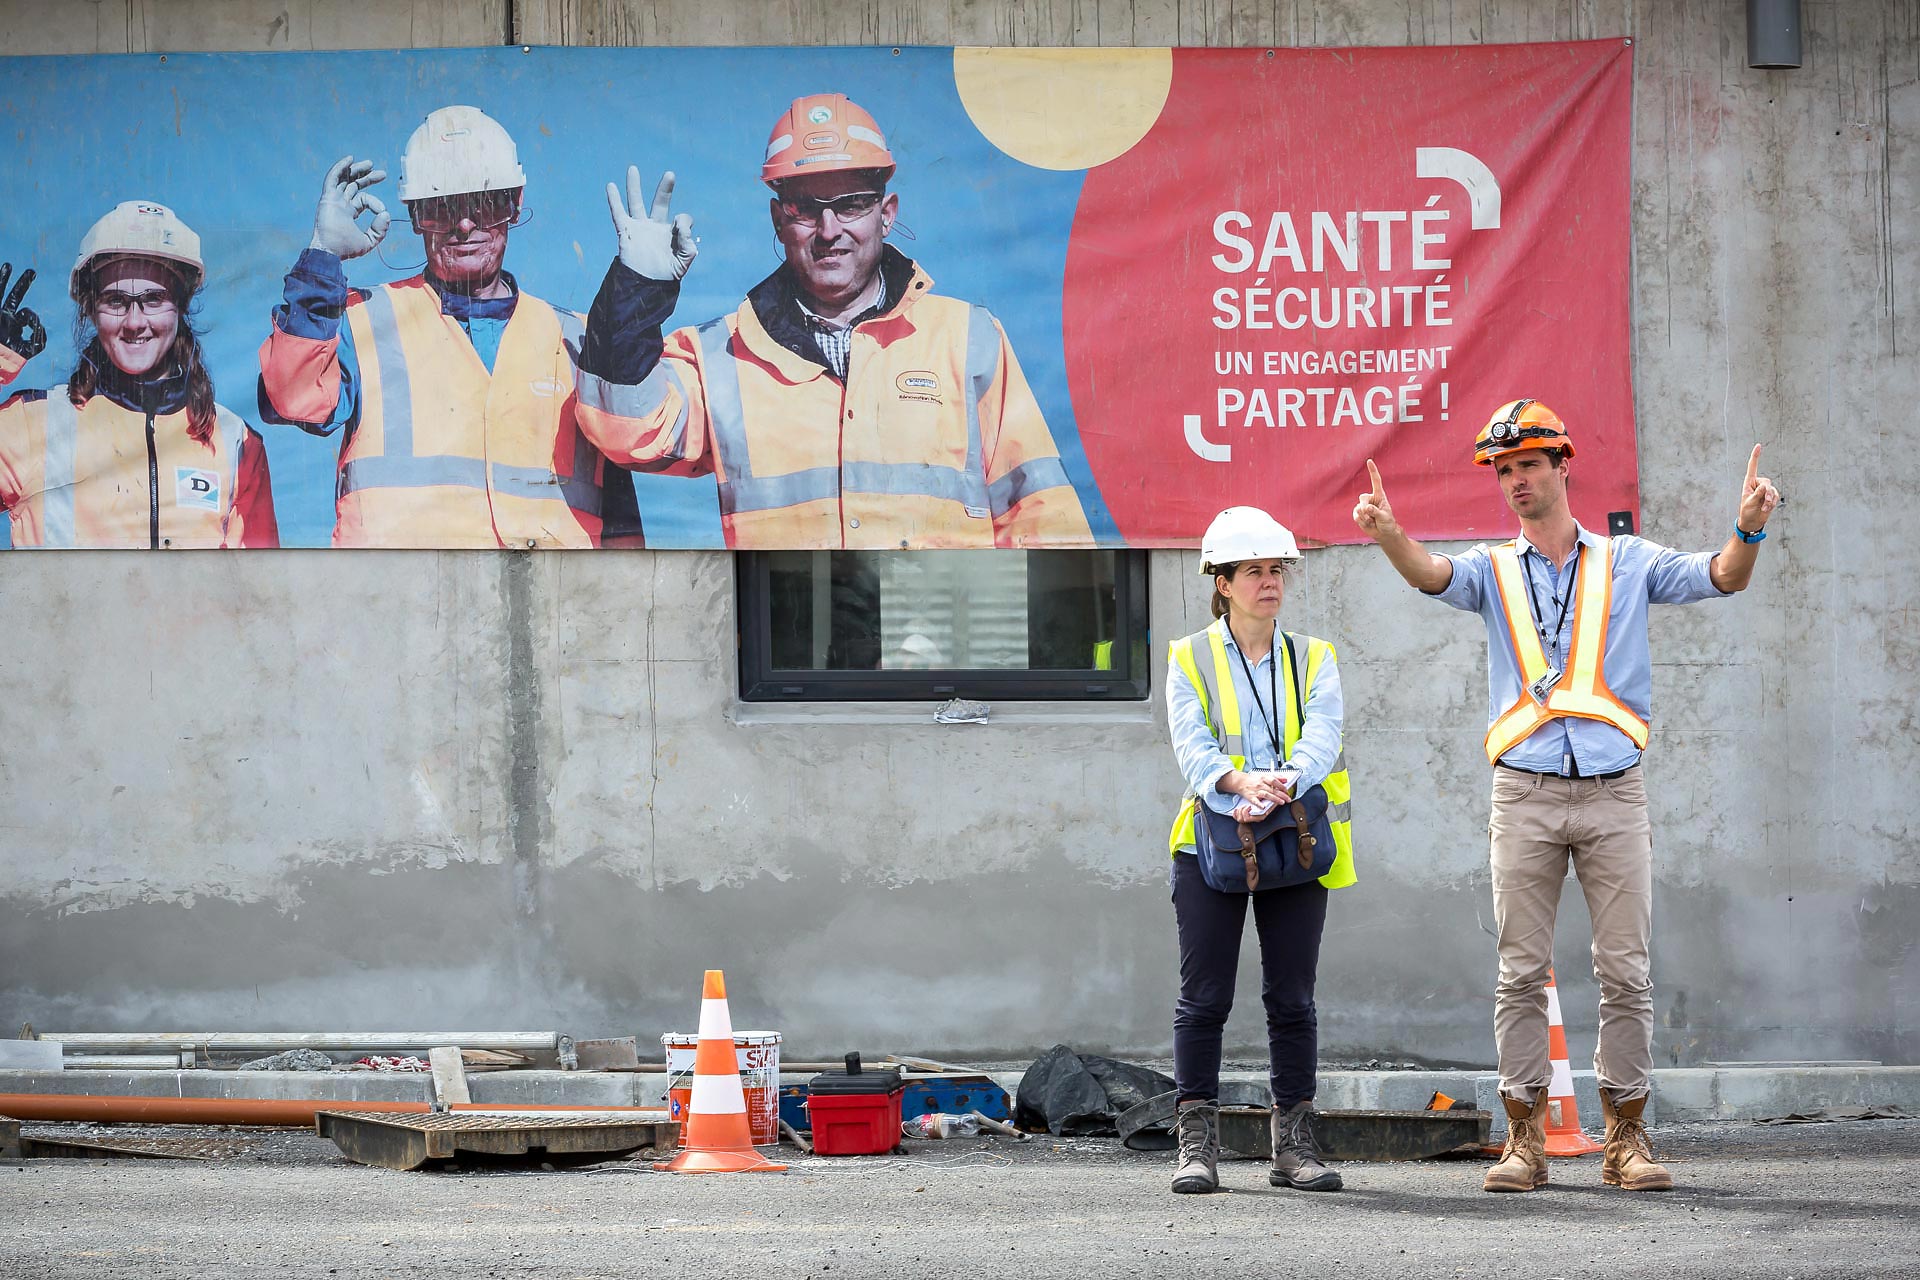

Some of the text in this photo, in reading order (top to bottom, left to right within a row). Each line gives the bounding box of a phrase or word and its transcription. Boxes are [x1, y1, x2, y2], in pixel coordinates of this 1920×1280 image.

[1211, 195, 1452, 273] SANTÉ
[1211, 274, 1453, 329] SÉCURITÉ
[1214, 345, 1453, 375] UN ENGAGEMENT
[1217, 375, 1449, 428] PARTAGÉ !
[191, 477, 210, 492] D
